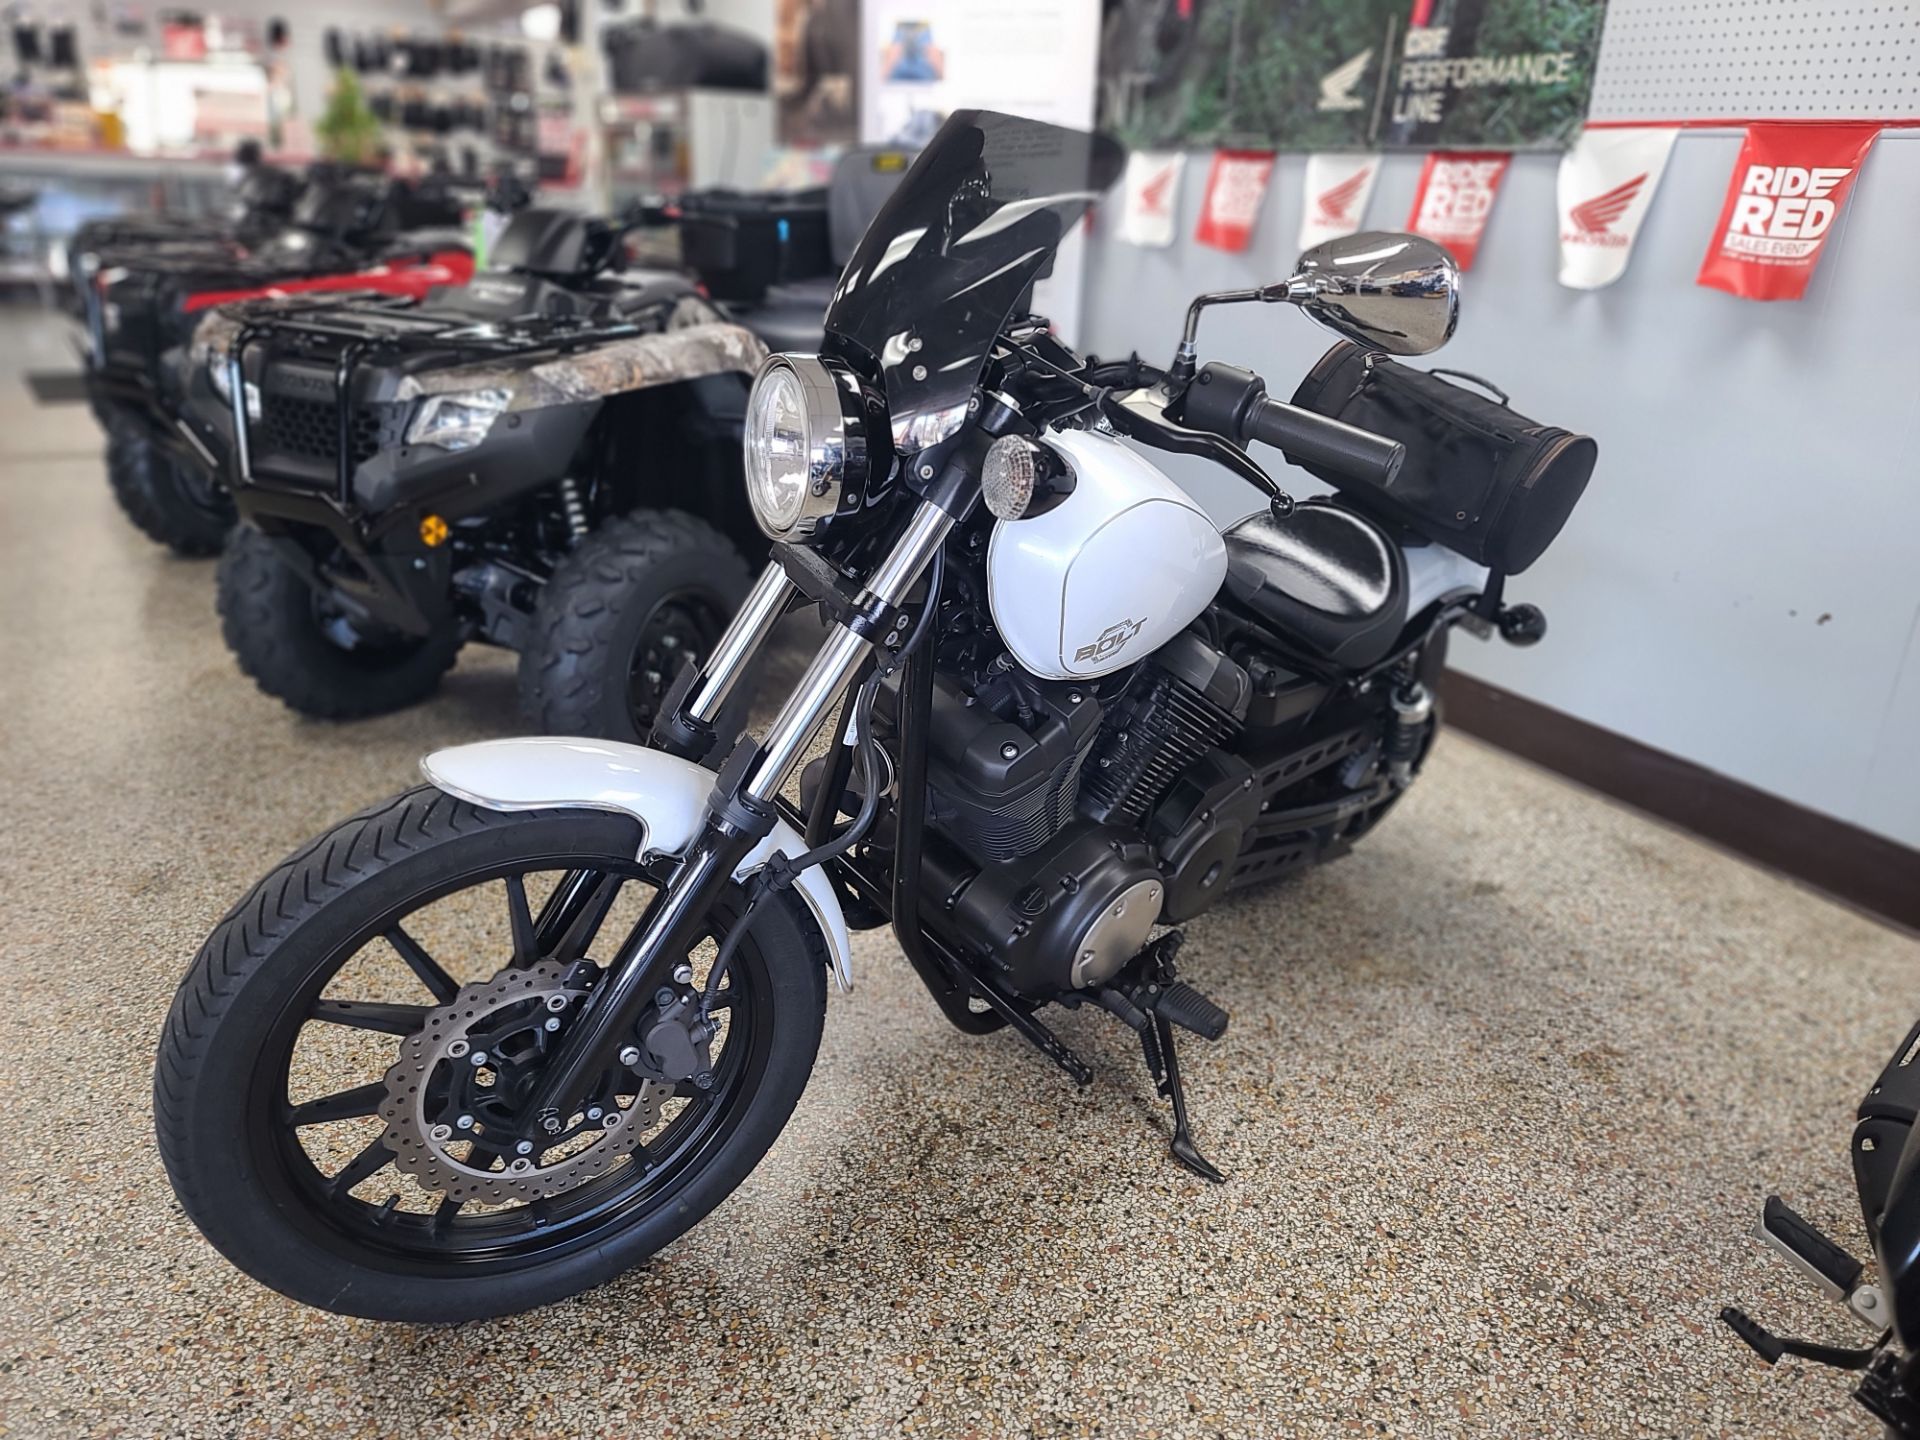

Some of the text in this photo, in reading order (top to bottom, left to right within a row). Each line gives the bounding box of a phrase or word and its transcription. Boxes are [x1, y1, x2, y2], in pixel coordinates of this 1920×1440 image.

[1400, 52, 1574, 90] PERFORMANCE
[1393, 91, 1446, 123] LINE
[1430, 162, 1502, 188] RIDE
[1741, 165, 1853, 198] RIDE
[1421, 188, 1492, 217] RED
[1729, 194, 1836, 239] RED
[1730, 236, 1809, 255] SALES EVENT
[1073, 615, 1148, 663] BOLT
